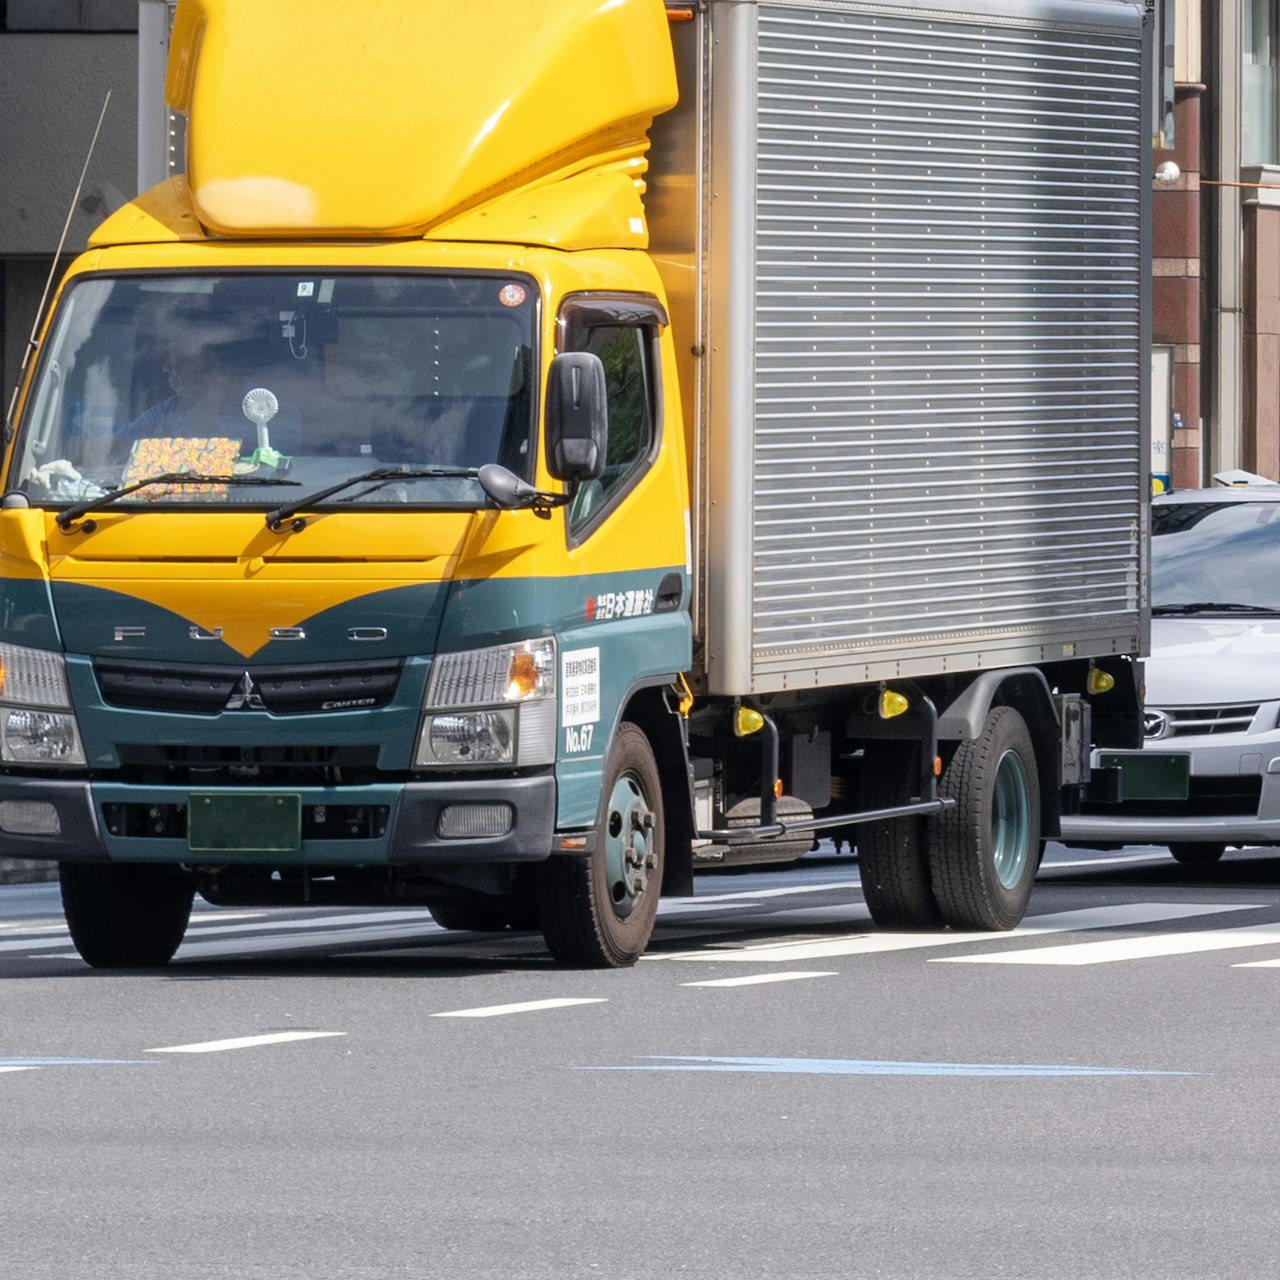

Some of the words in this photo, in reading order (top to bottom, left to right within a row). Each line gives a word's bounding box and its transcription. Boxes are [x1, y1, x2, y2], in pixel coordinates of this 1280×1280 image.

[114, 625, 389, 642] FUSO
[321, 697, 376, 710] CANTER
[566, 724, 594, 753] No.67
